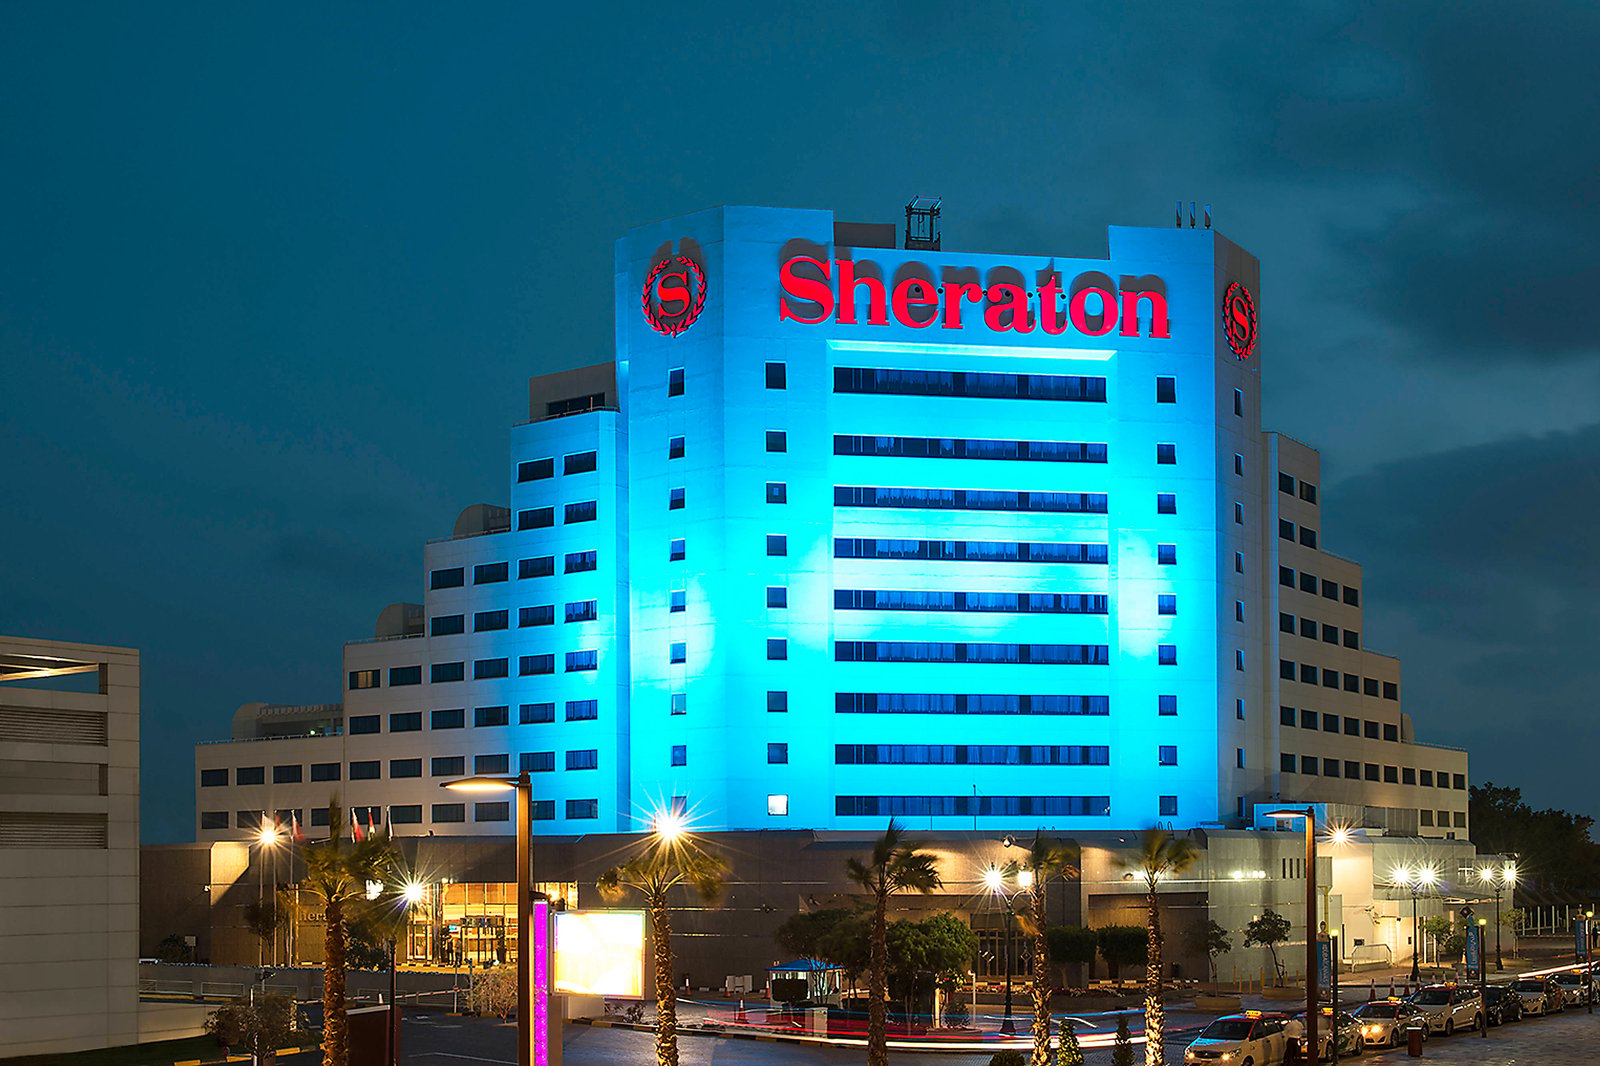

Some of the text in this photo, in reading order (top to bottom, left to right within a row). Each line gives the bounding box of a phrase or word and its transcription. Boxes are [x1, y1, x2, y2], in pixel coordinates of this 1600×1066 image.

[657, 269, 691, 319] S
[779, 256, 1171, 339] Sheraton
[1232, 296, 1250, 342] S
